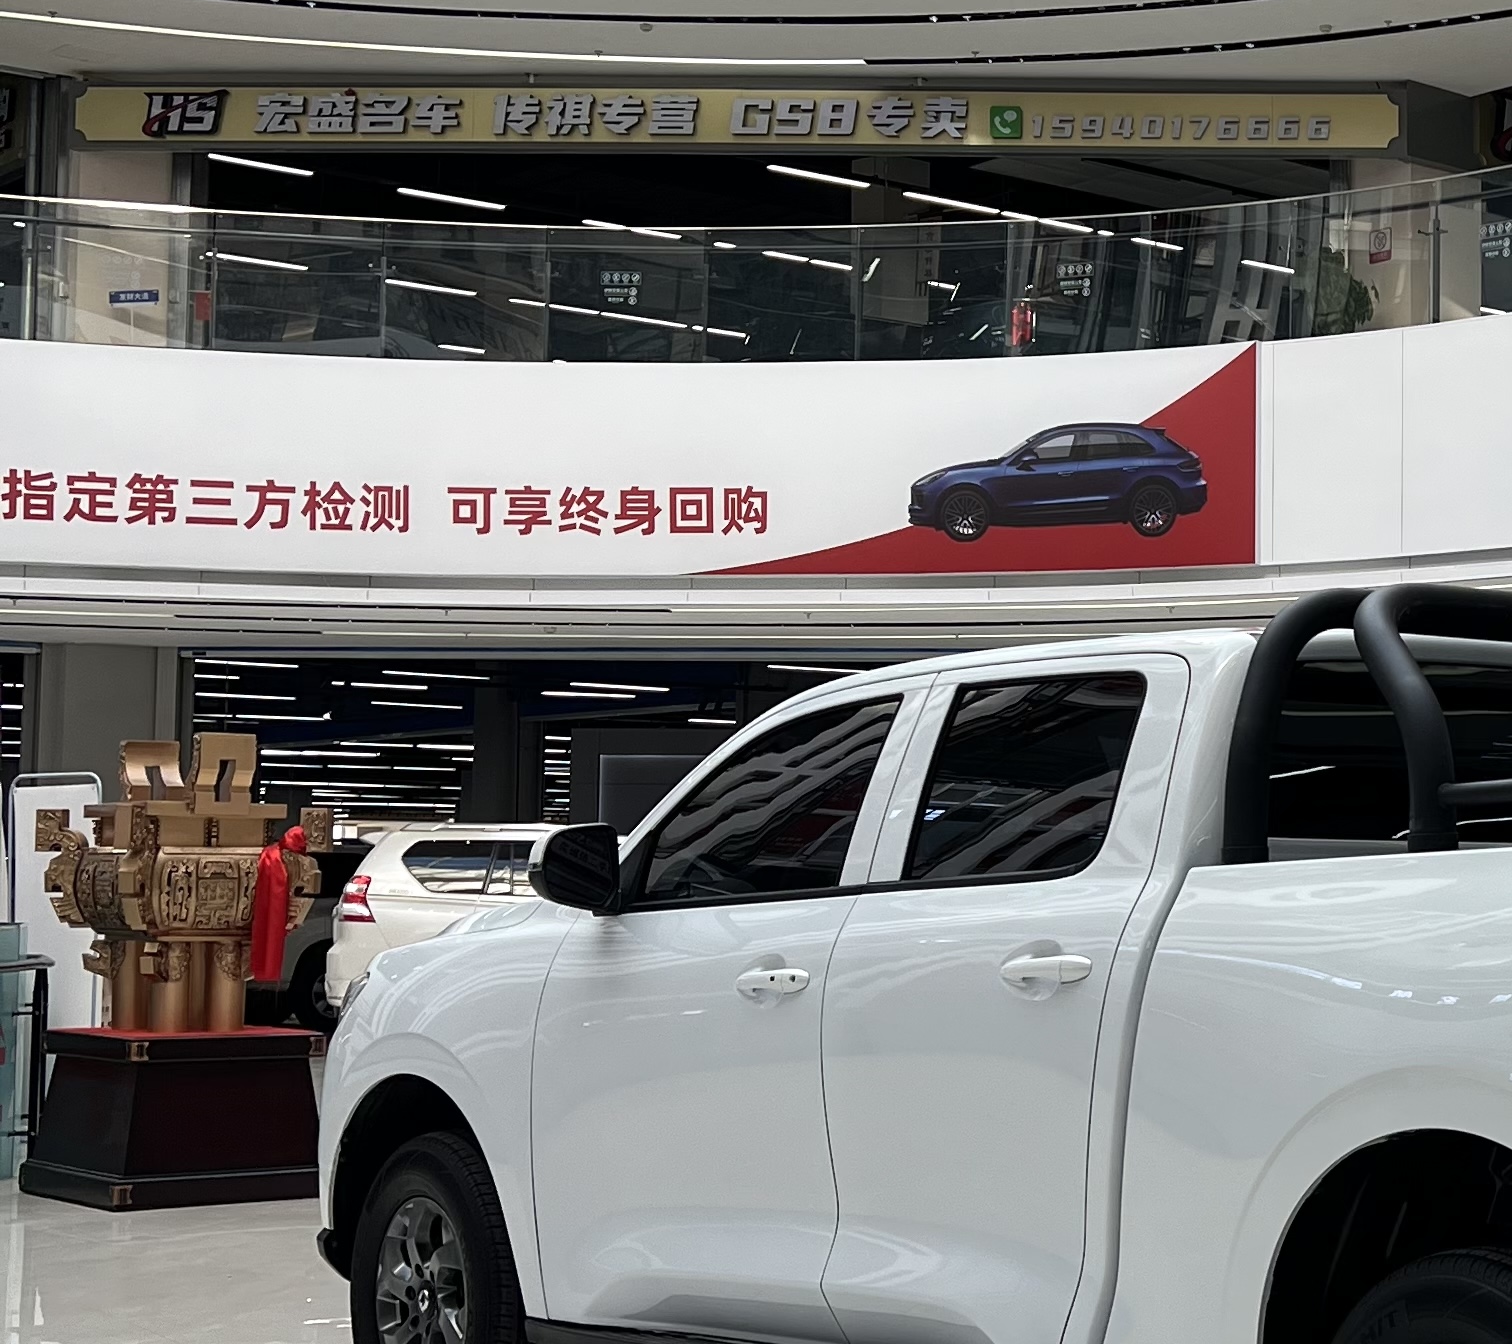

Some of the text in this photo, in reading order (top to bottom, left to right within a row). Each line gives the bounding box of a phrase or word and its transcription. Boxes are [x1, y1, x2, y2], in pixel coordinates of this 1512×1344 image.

[145, 90, 227, 137] HS
[253, 92, 462, 135] 宏盛名车
[491, 92, 700, 137] 传祺专营
[1031, 114, 1331, 141] 15940176666
[0, 468, 769, 536] 指定第三方检测 可享终身回购
